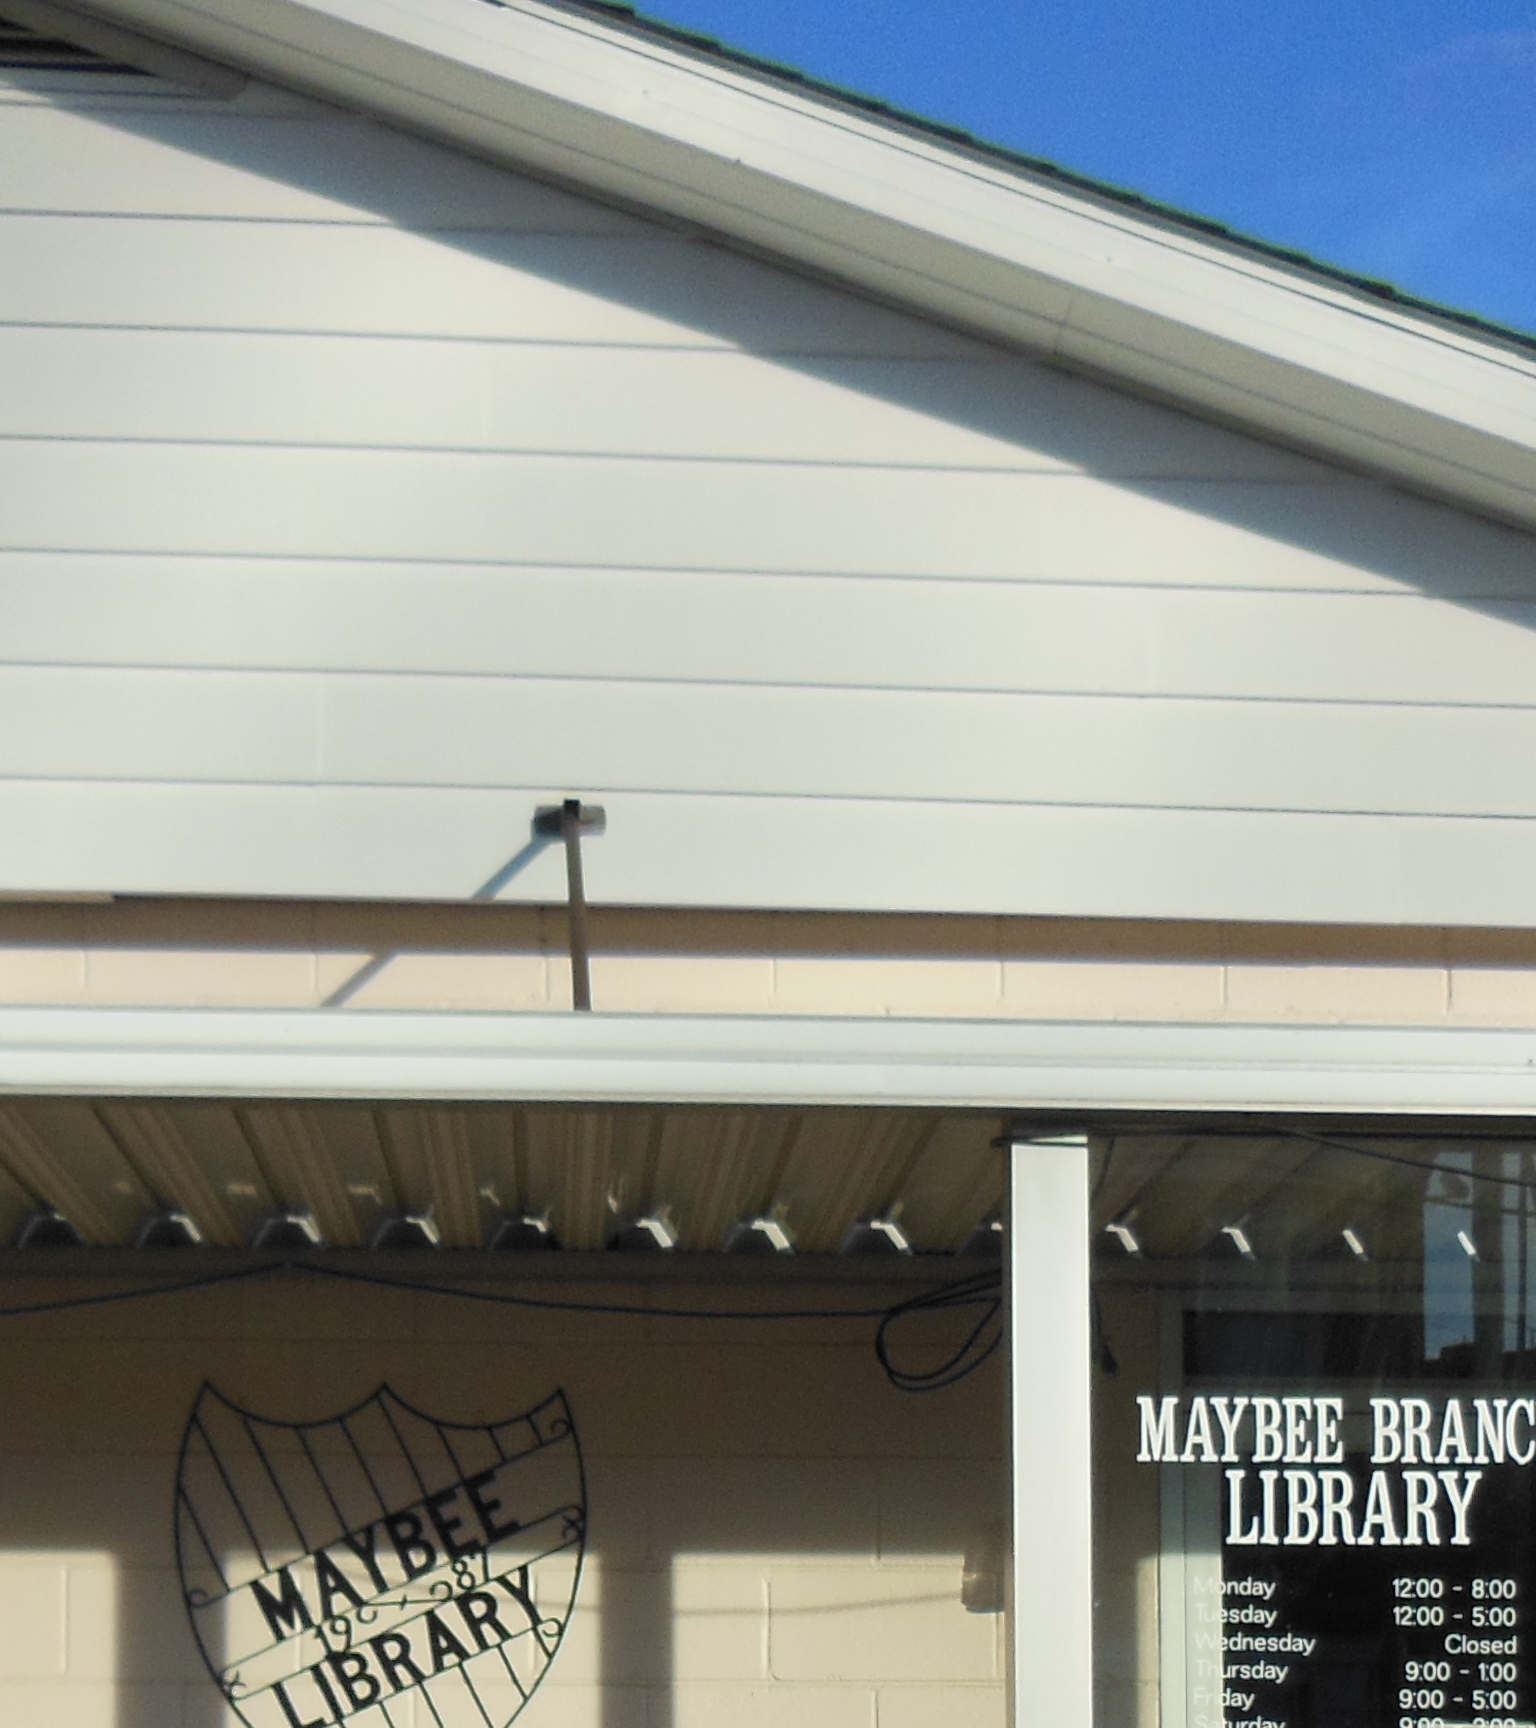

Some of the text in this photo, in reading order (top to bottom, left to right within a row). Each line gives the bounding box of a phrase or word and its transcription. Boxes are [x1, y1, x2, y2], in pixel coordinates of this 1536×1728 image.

[1136, 1396, 1344, 1463] MAYBEE
[1225, 1469, 1482, 1546] LIBRARY
[249, 1470, 521, 1642] MAYBEE
[1193, 1577, 1276, 1599] Monday
[1392, 1578, 1444, 1598] 12:00
[1471, 1578, 1517, 1599] 8:00
[1194, 1604, 1277, 1628] Tuesday
[1393, 1606, 1444, 1626] 12:00
[1472, 1606, 1517, 1627] 5:00
[1195, 1632, 1316, 1656] Wednesday
[1444, 1633, 1518, 1654] Closed
[1196, 1660, 1289, 1684] Thursday
[1405, 1661, 1451, 1682] 9:00
[1477, 1662, 1517, 1682] 1:00
[1193, 1687, 1255, 1711] Friday
[1398, 1689, 1445, 1709] 9:00
[1472, 1690, 1517, 1710] 5:00
